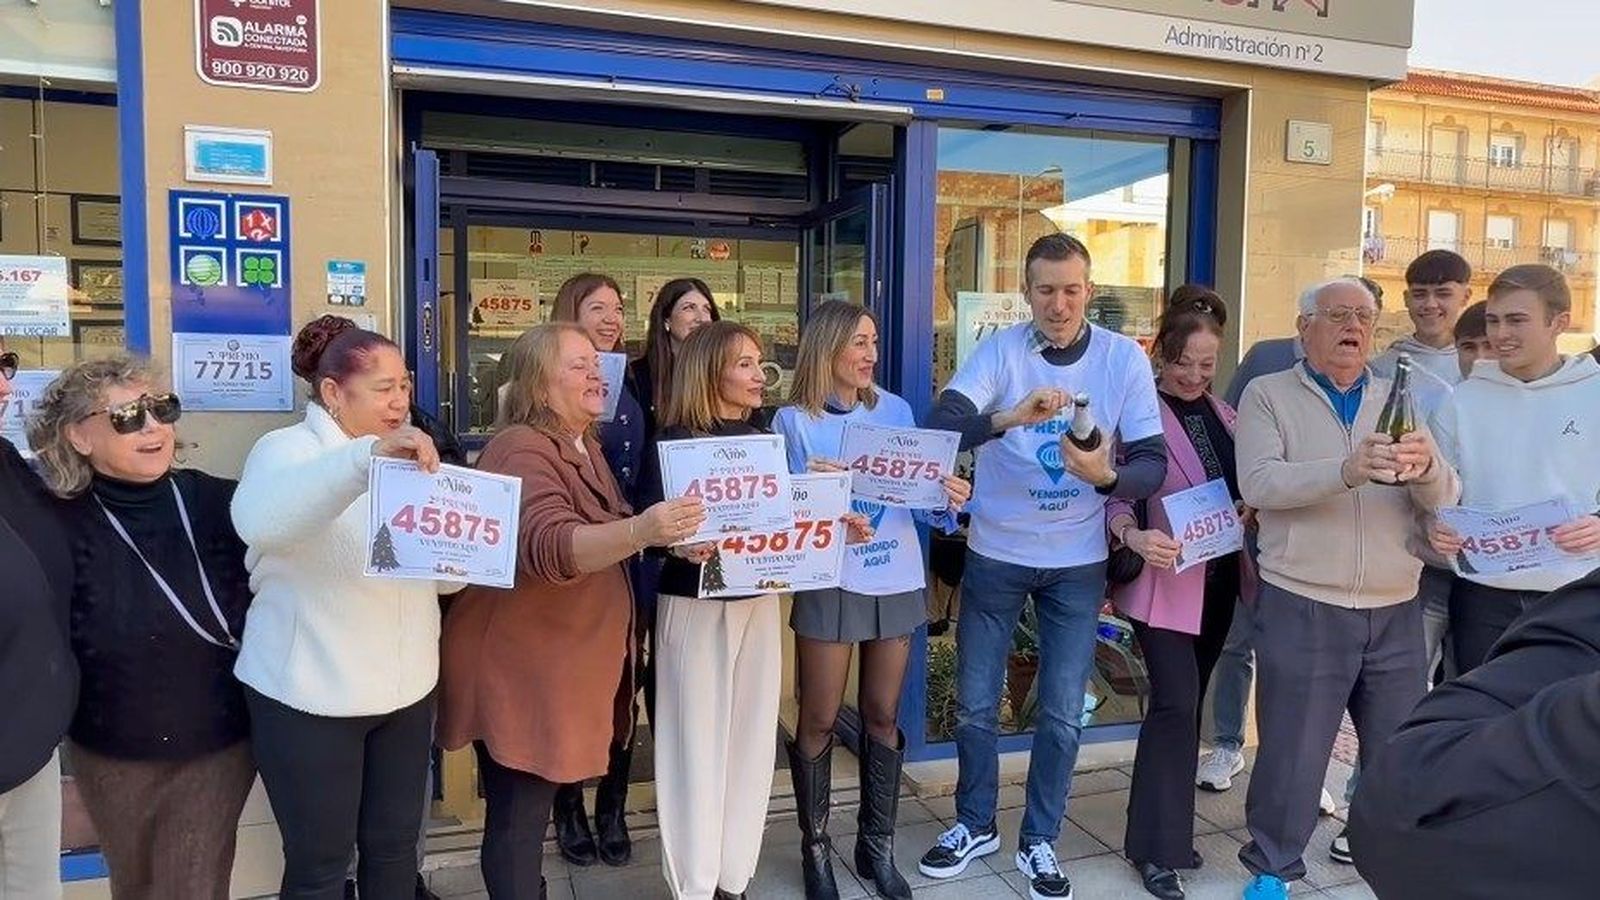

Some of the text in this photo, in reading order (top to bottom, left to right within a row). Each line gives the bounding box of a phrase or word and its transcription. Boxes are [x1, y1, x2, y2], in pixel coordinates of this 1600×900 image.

[244, 21, 308, 38] ALARMA
[244, 33, 308, 47] CONECTADA
[1164, 25, 1290, 58] Administración
[1313, 44, 1324, 62] 2
[212, 61, 309, 81] 900 920 920
[1303, 140, 1314, 157] 5
[479, 298, 532, 311] 45875
[194, 360, 273, 380] 77715
[851, 454, 940, 480] 45875
[684, 474, 778, 502] 45875
[1028, 488, 1080, 499] VENDIDO
[391, 504, 501, 545] 45875
[1184, 510, 1235, 541] 45875
[722, 520, 833, 554] 45875
[852, 539, 899, 556] VENDIDO
